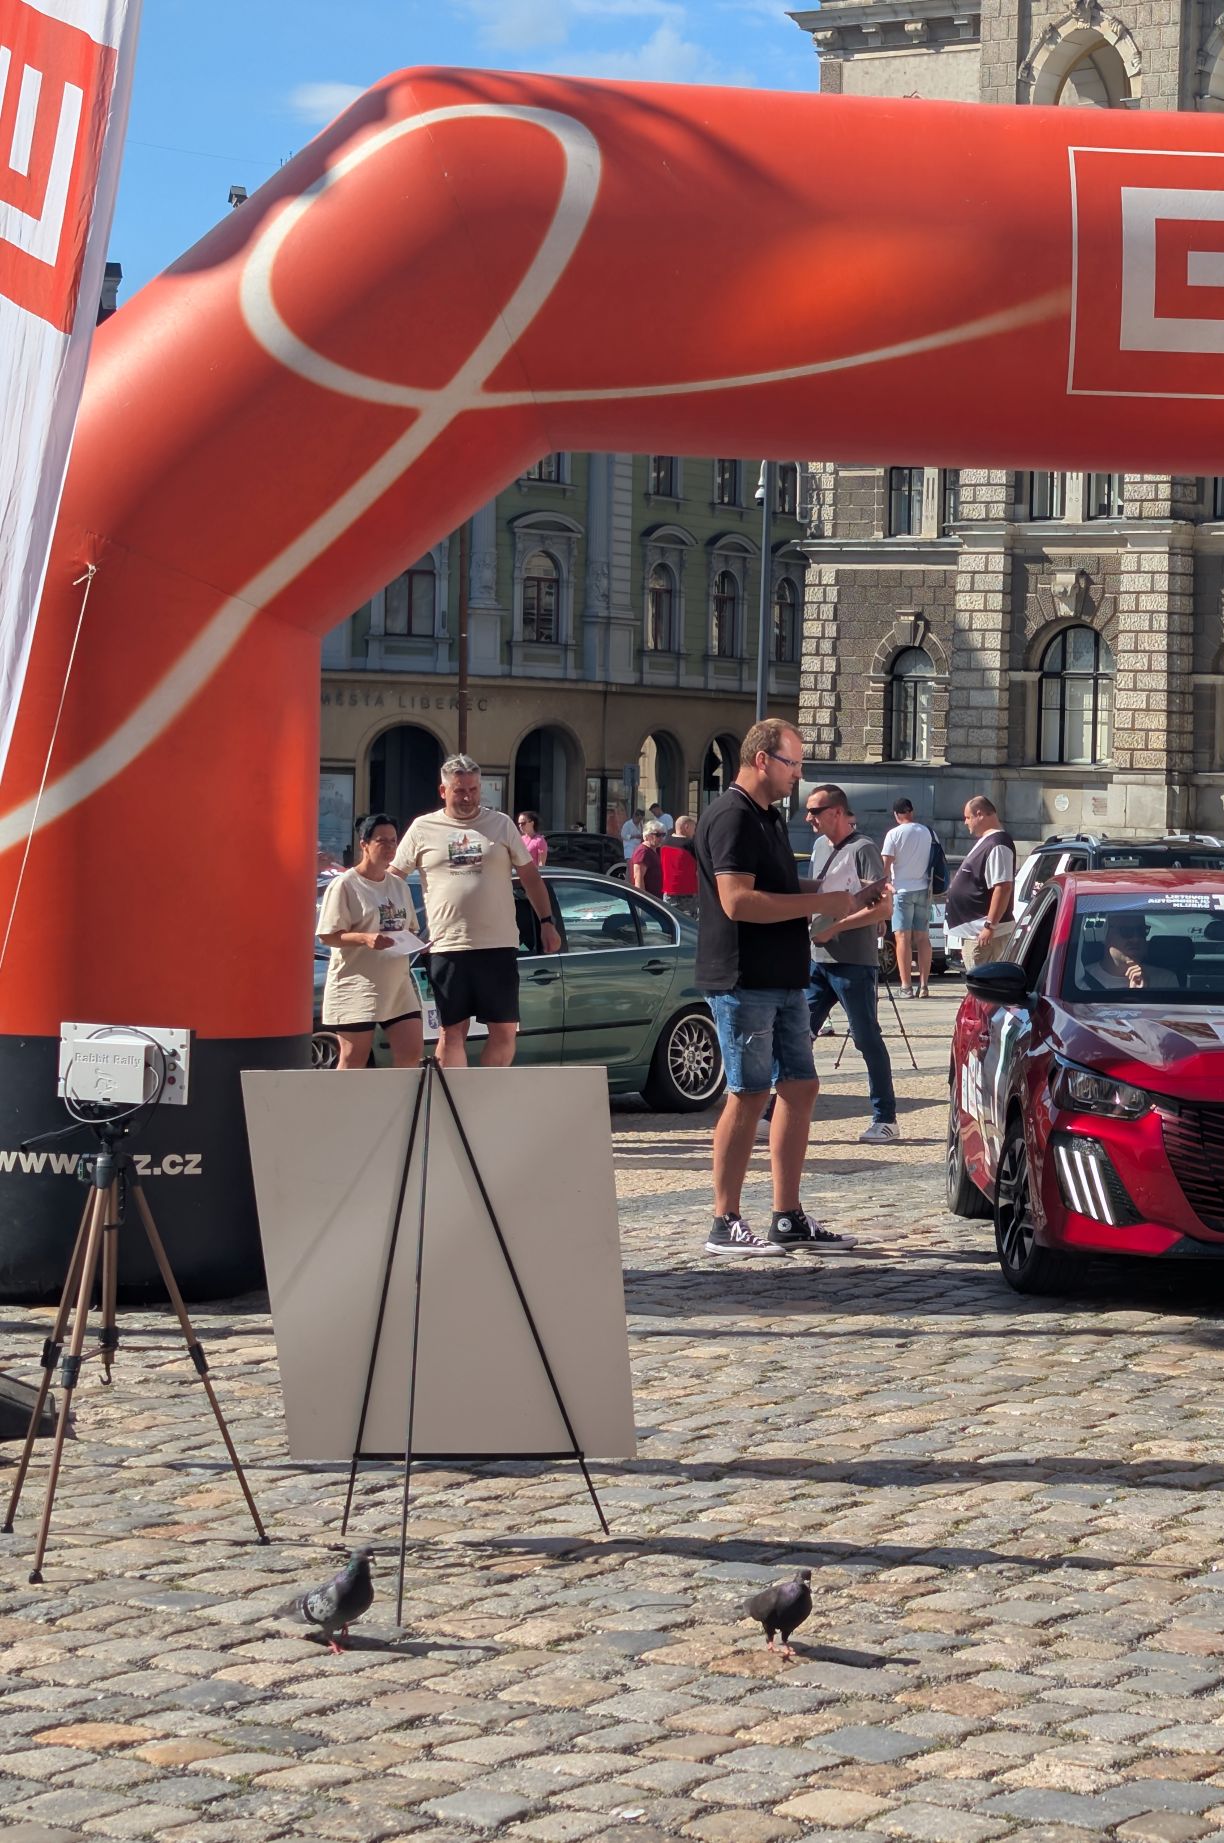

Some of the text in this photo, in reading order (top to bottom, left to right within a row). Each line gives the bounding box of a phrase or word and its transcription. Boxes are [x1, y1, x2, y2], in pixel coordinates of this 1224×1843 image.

[398, 695, 488, 711] LIBEREC
[74, 1052, 143, 1069] Rabbit Rally
[0, 1150, 203, 1175] wwwz.cz
